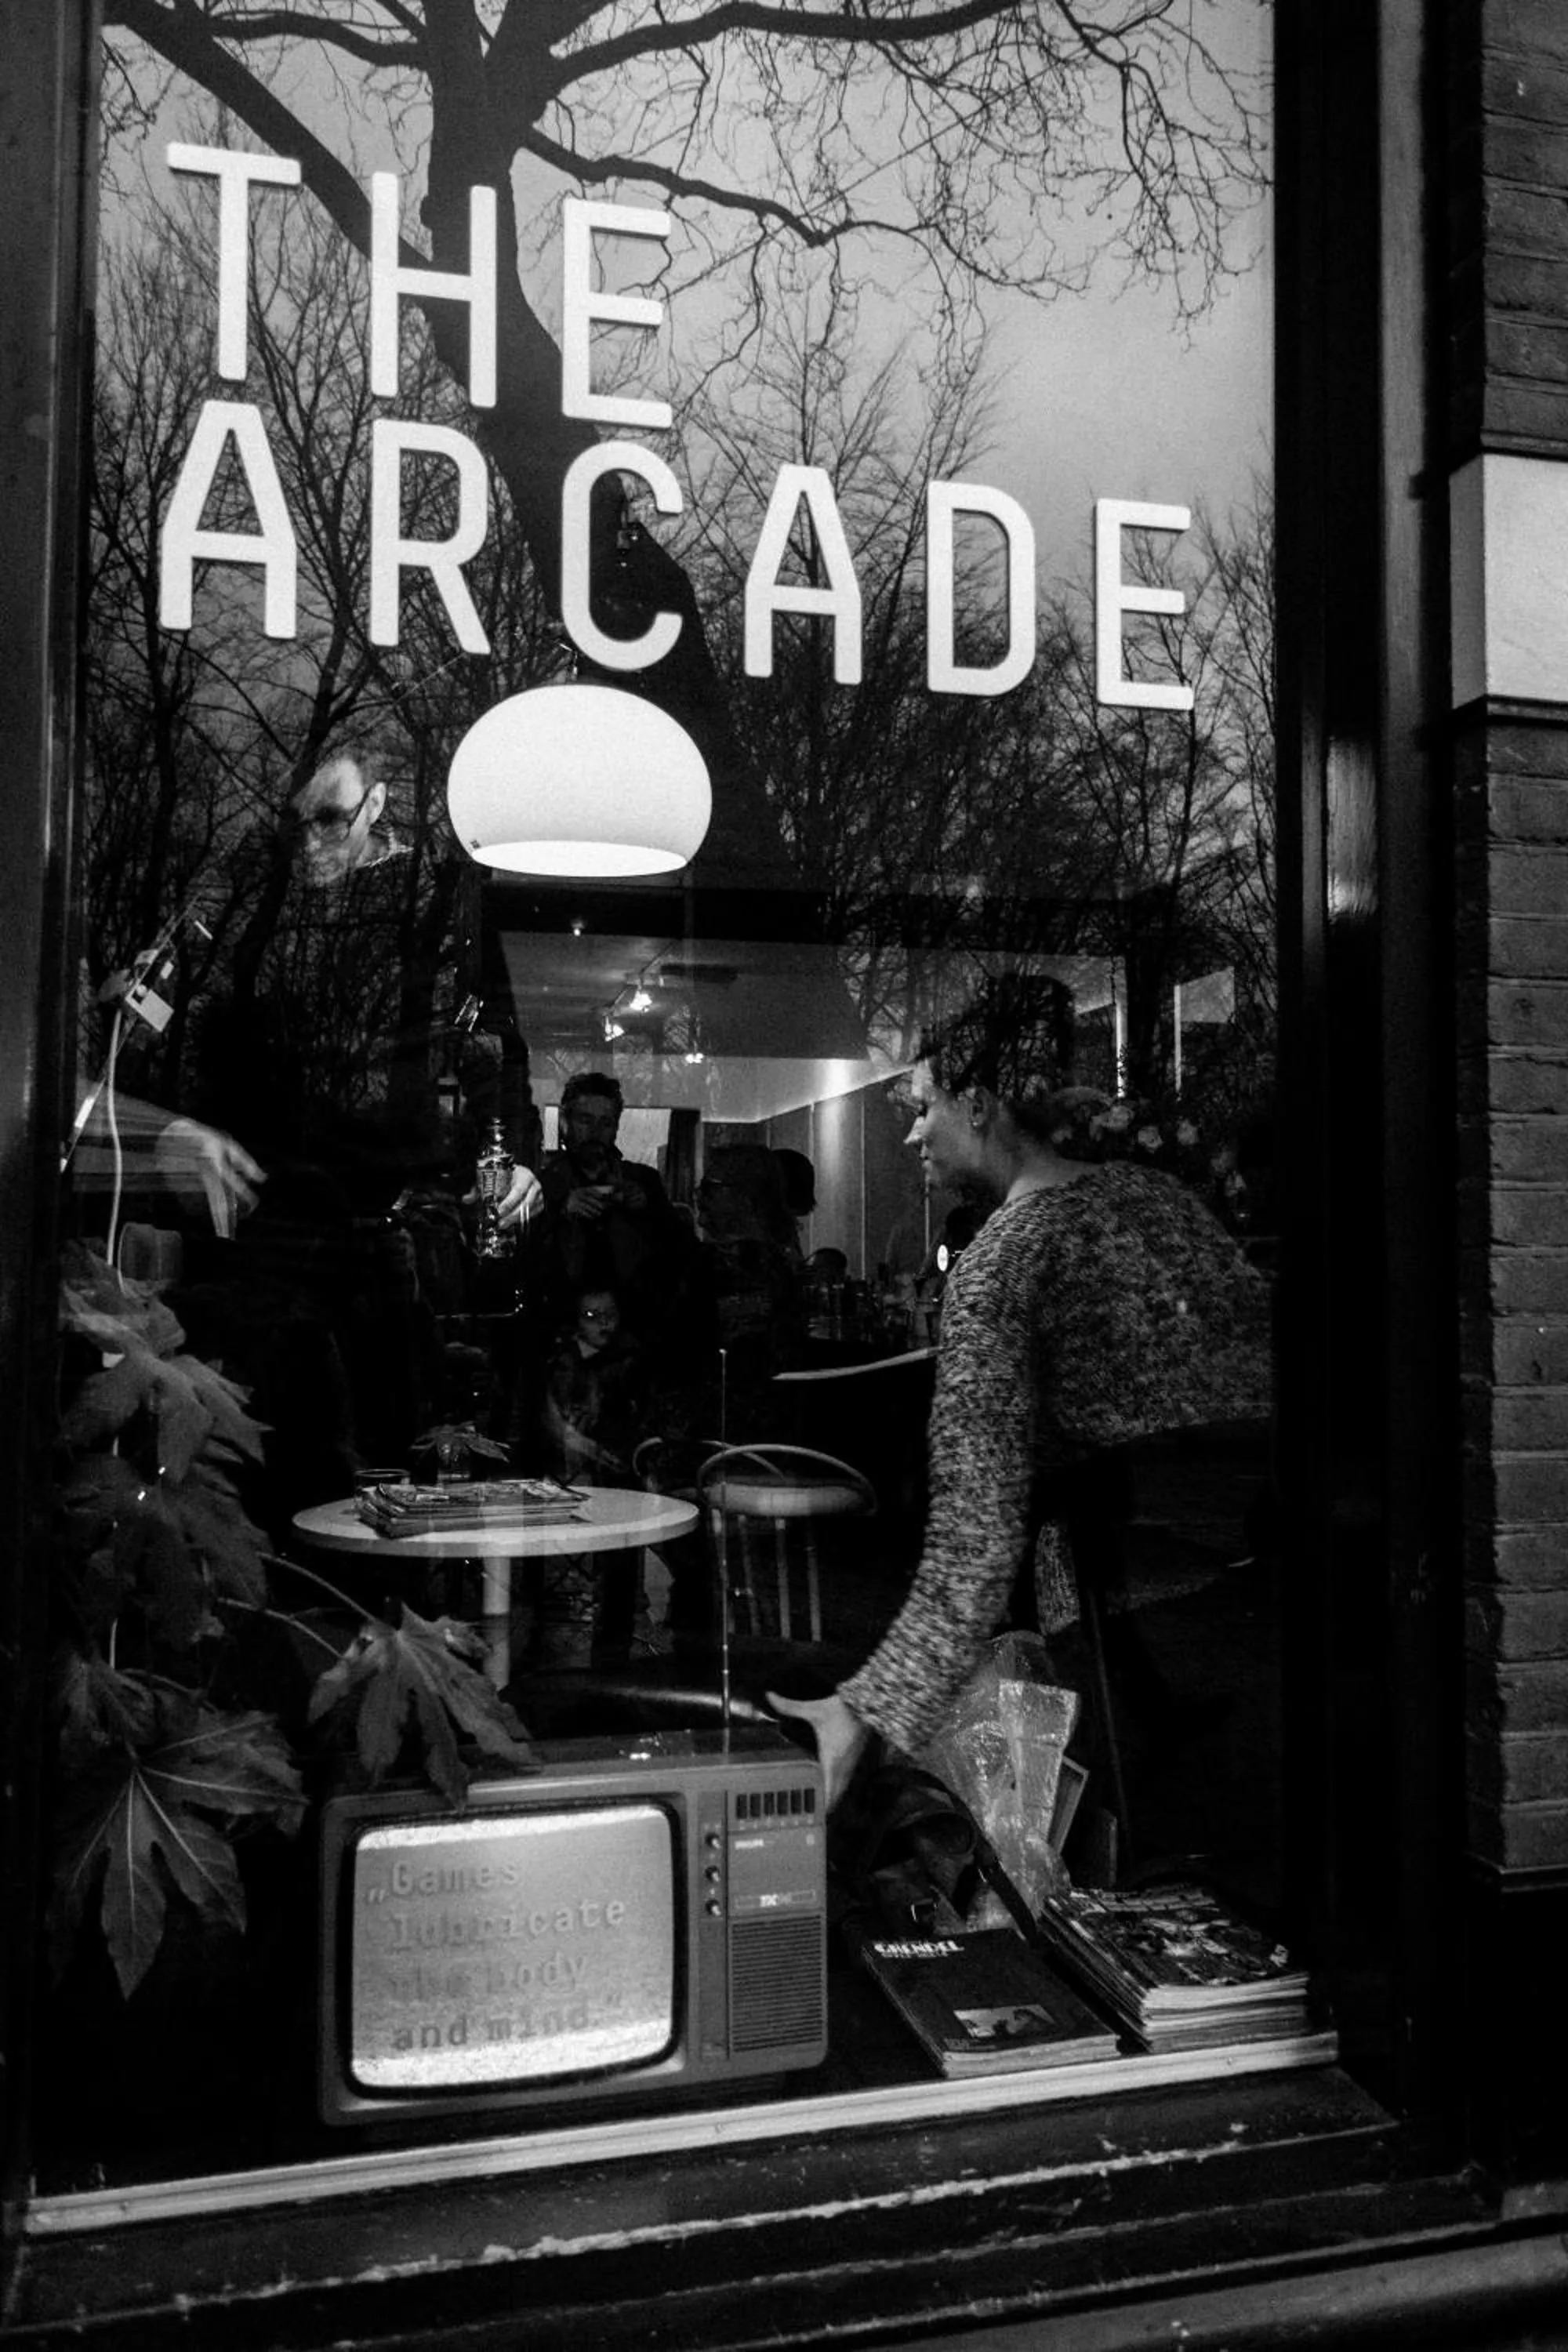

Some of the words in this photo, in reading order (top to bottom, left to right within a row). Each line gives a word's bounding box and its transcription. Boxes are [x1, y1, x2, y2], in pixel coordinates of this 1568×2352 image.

[166, 142, 673, 429] THE
[158, 398, 1195, 711] ARCADE
[390, 2012, 468, 2051] and
